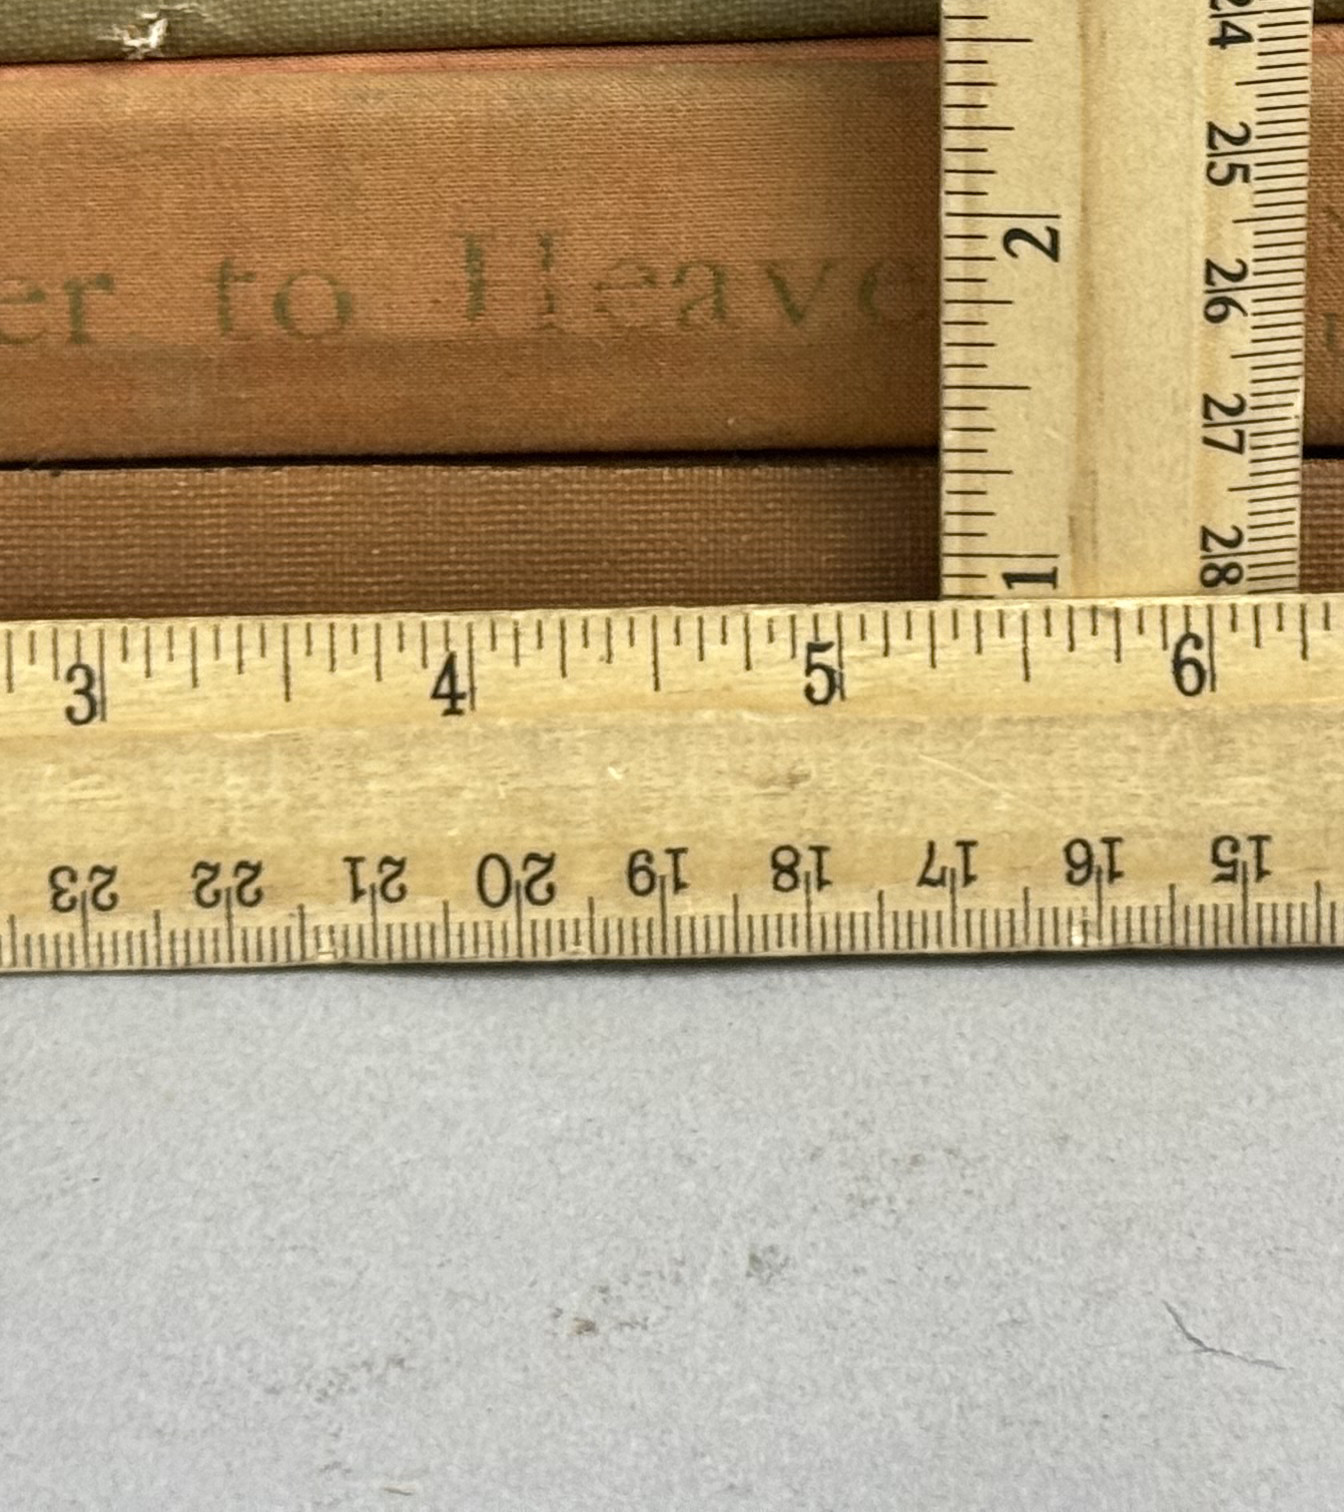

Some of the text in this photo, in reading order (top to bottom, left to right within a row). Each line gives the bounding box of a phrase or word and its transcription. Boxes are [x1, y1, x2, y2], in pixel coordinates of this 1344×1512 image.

[1206, 121, 1252, 186] 25
[1002, 226, 1060, 262] 2
[211, 256, 354, 341] to
[456, 230, 908, 333] Heave
[1203, 258, 1249, 324] 26
[1202, 393, 1246, 456] 27
[1002, 566, 1058, 589] 1
[1199, 525, 1244, 589] 28
[65, 662, 99, 725] 3
[431, 650, 467, 716] 4
[805, 641, 837, 706] 5
[1173, 633, 1206, 697] 6
[343, 855, 407, 904] 21
[477, 852, 556, 908] 20
[627, 847, 689, 896] 19
[770, 844, 832, 892] 18
[918, 839, 978, 888] 17
[1064, 836, 1124, 886] 16
[1211, 834, 1272, 883] 15
[48, 864, 119, 913] 23
[192, 860, 264, 908] 22
